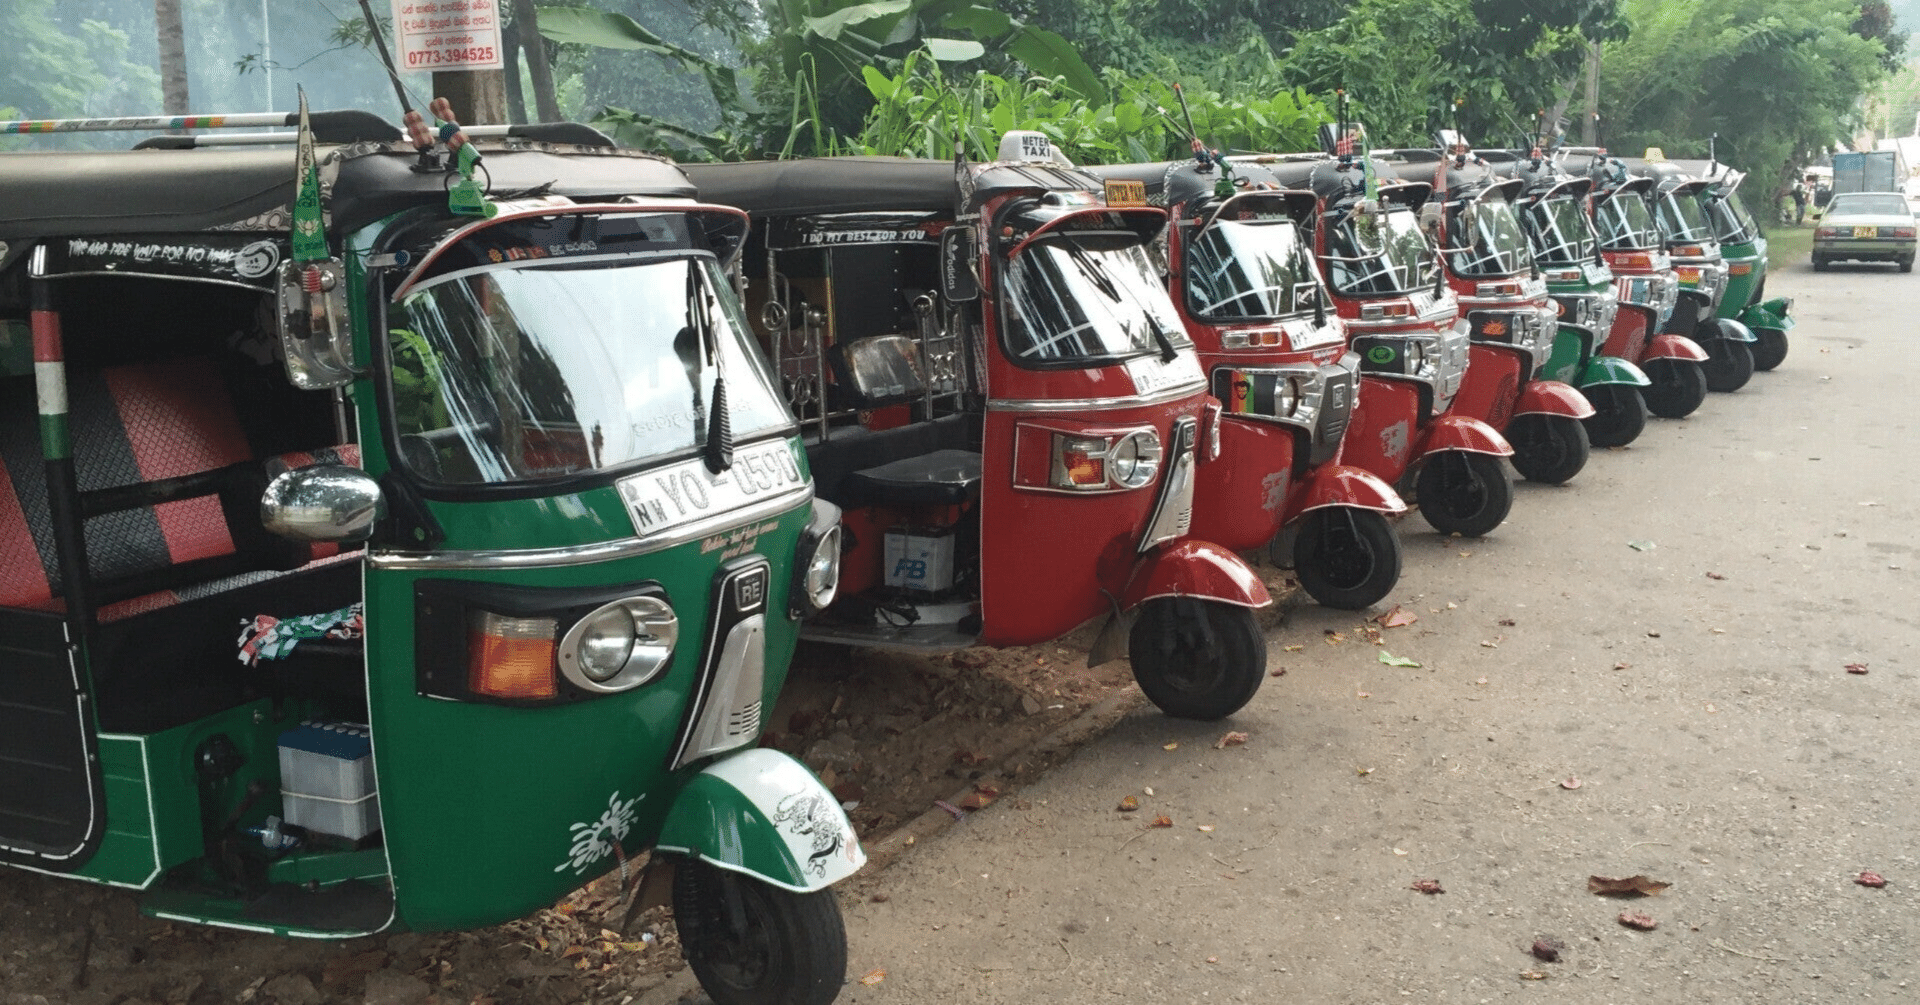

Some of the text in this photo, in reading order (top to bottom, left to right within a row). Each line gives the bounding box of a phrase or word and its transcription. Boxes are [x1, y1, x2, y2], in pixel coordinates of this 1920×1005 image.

[408, 46, 493, 65] 0773-394525
[1022, 136, 1050, 147] METER
[1023, 146, 1050, 157] TAXI
[802, 230, 926, 244] I DO MY BEST FOR YOU
[161, 245, 184, 260] FOR
[185, 246, 206, 261] NO
[947, 259, 955, 290] adidas
[634, 498, 668, 527] NW
[742, 581, 760, 603] RE
